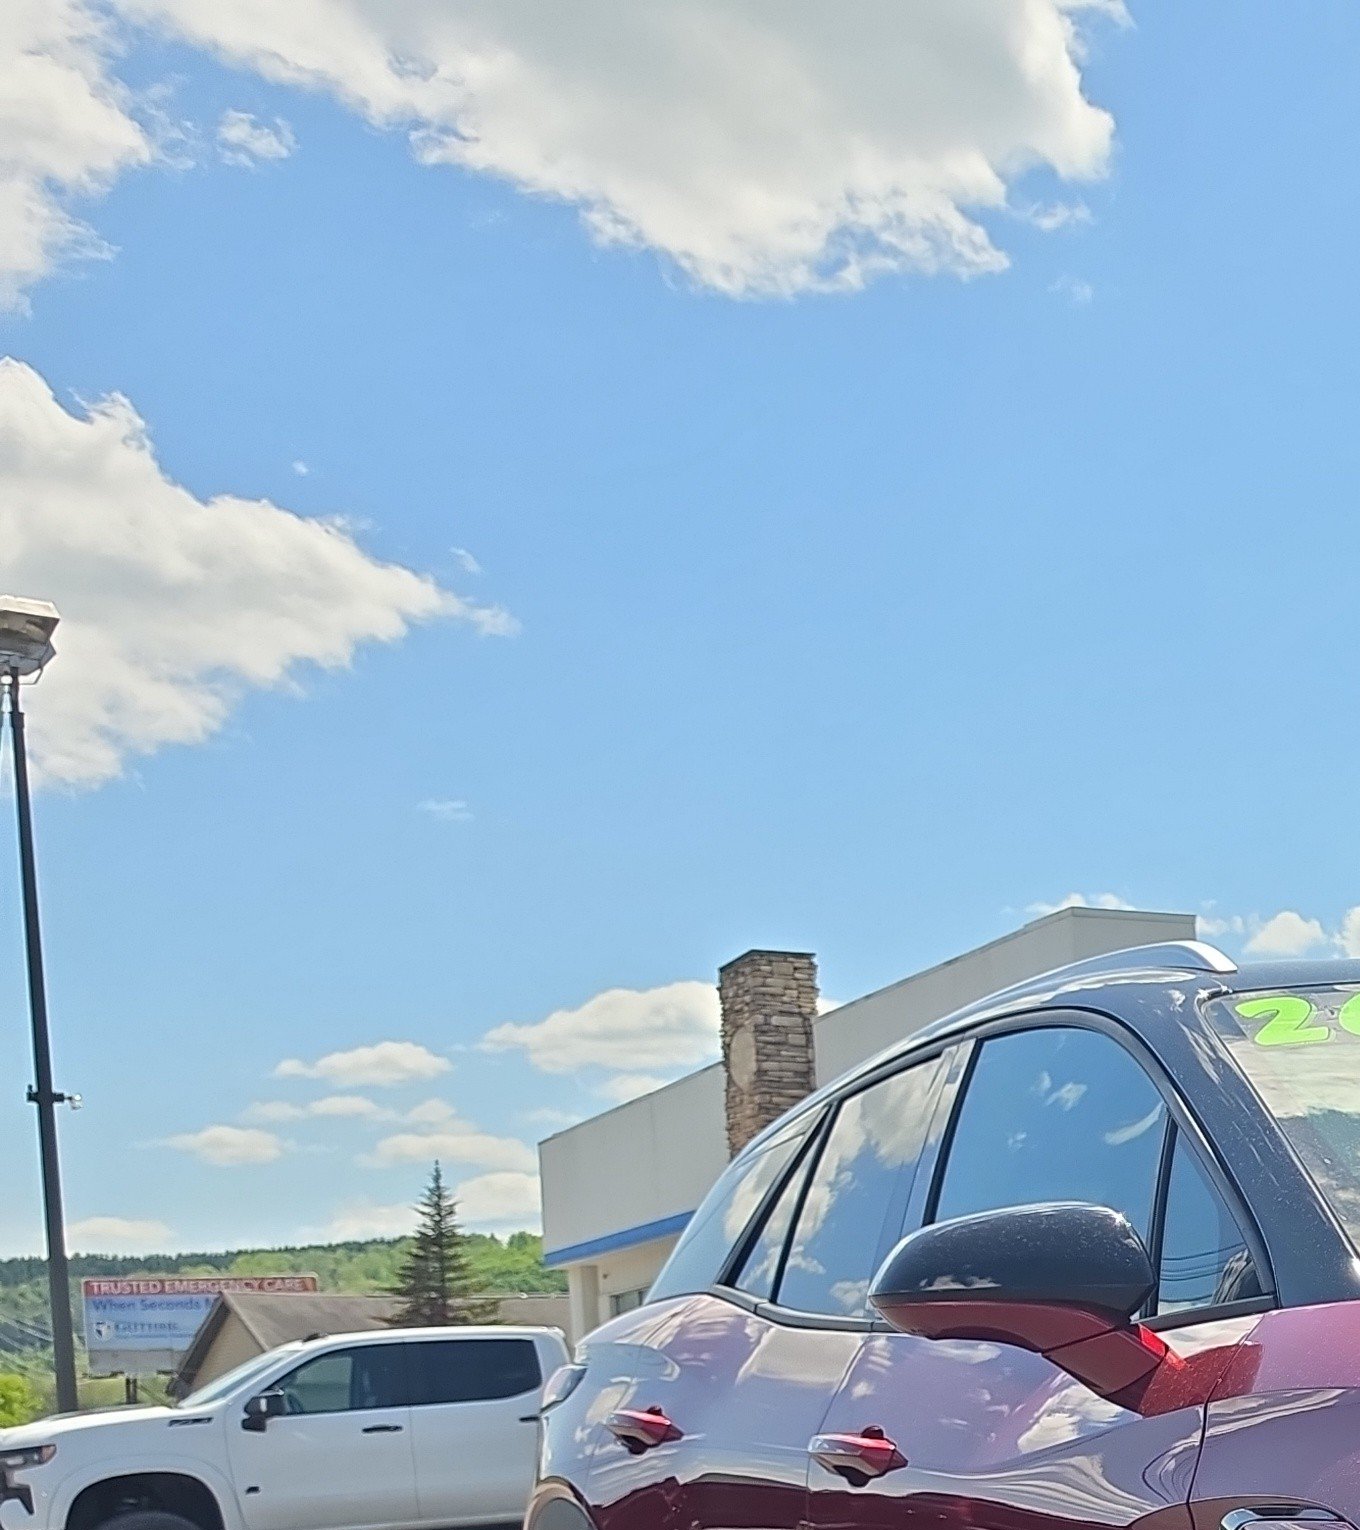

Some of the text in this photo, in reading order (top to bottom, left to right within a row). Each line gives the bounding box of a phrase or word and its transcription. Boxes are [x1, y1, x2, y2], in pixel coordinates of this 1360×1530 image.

[90, 1278, 305, 1295] TRUSTED EMERGENCY CARE
[92, 1298, 137, 1312] When
[139, 1298, 201, 1312] Seconds
